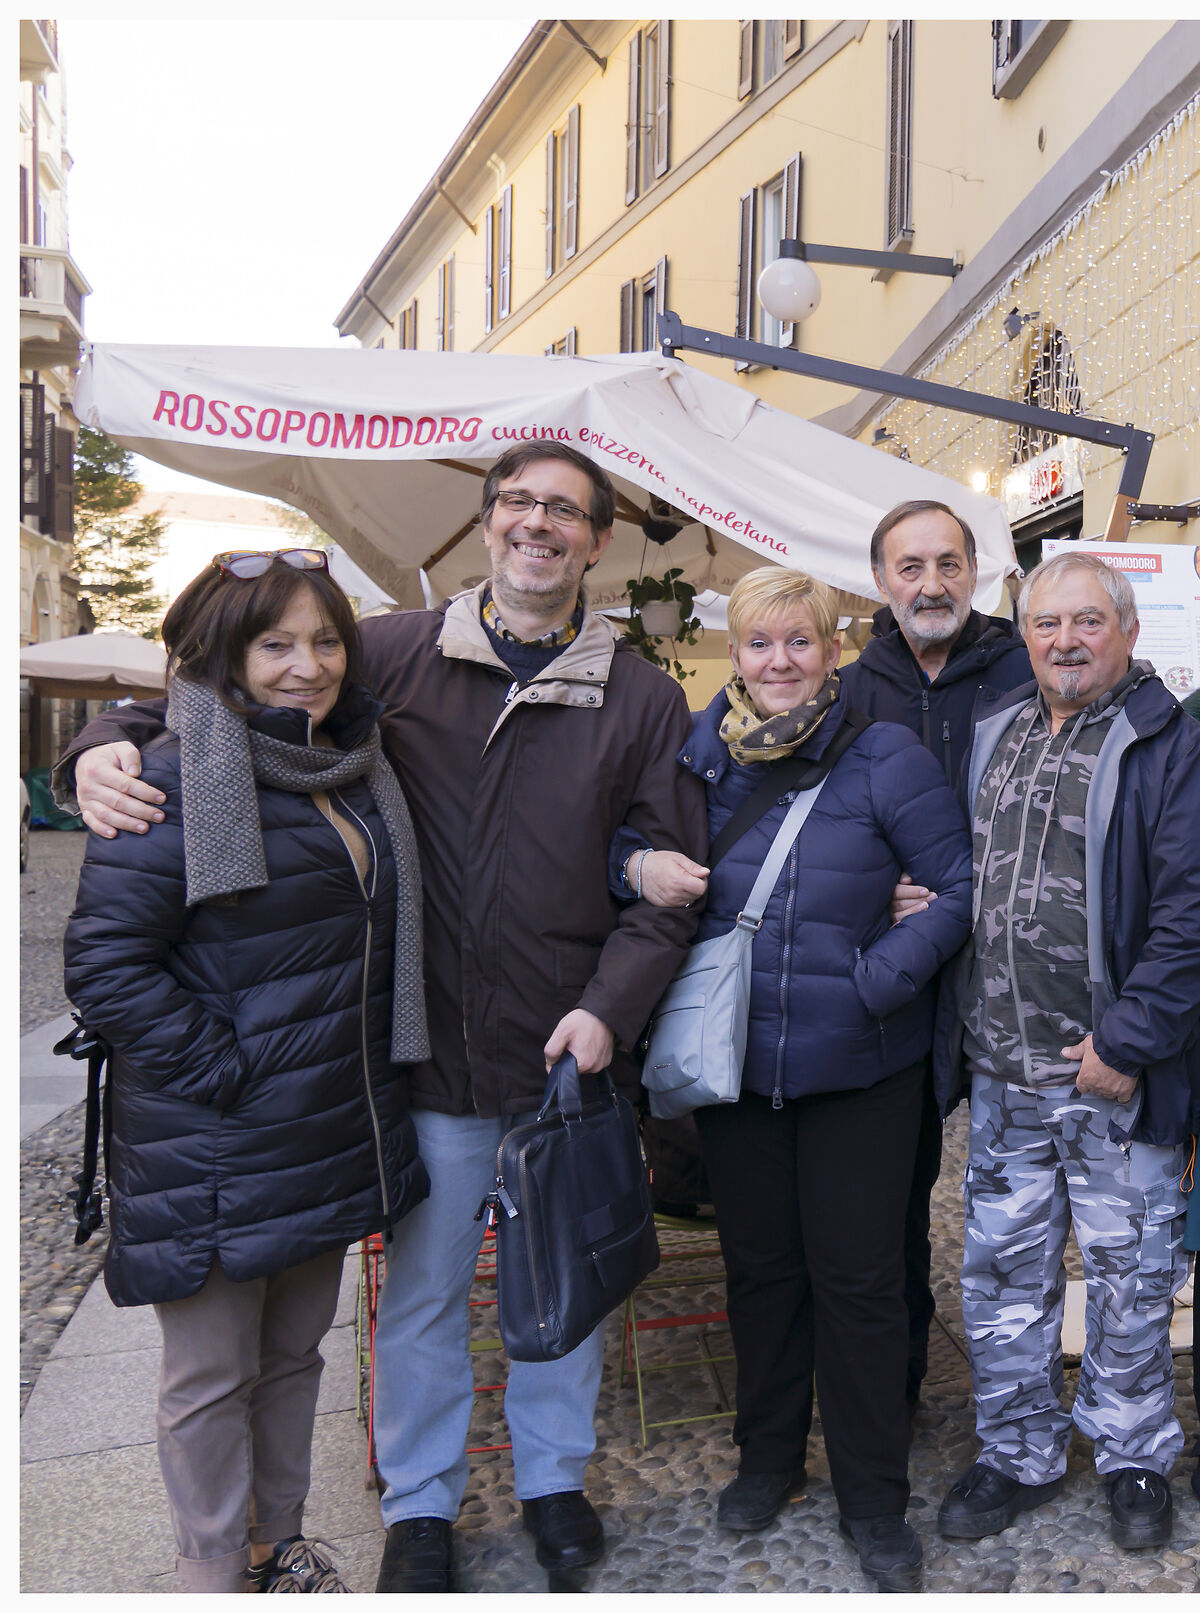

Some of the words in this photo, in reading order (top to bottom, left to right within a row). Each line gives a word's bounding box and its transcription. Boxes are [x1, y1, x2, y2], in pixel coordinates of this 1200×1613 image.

[152, 390, 483, 449] ROSSOPOMODORO
[491, 423, 572, 441] cucina
[675, 486, 792, 556] napoletana
